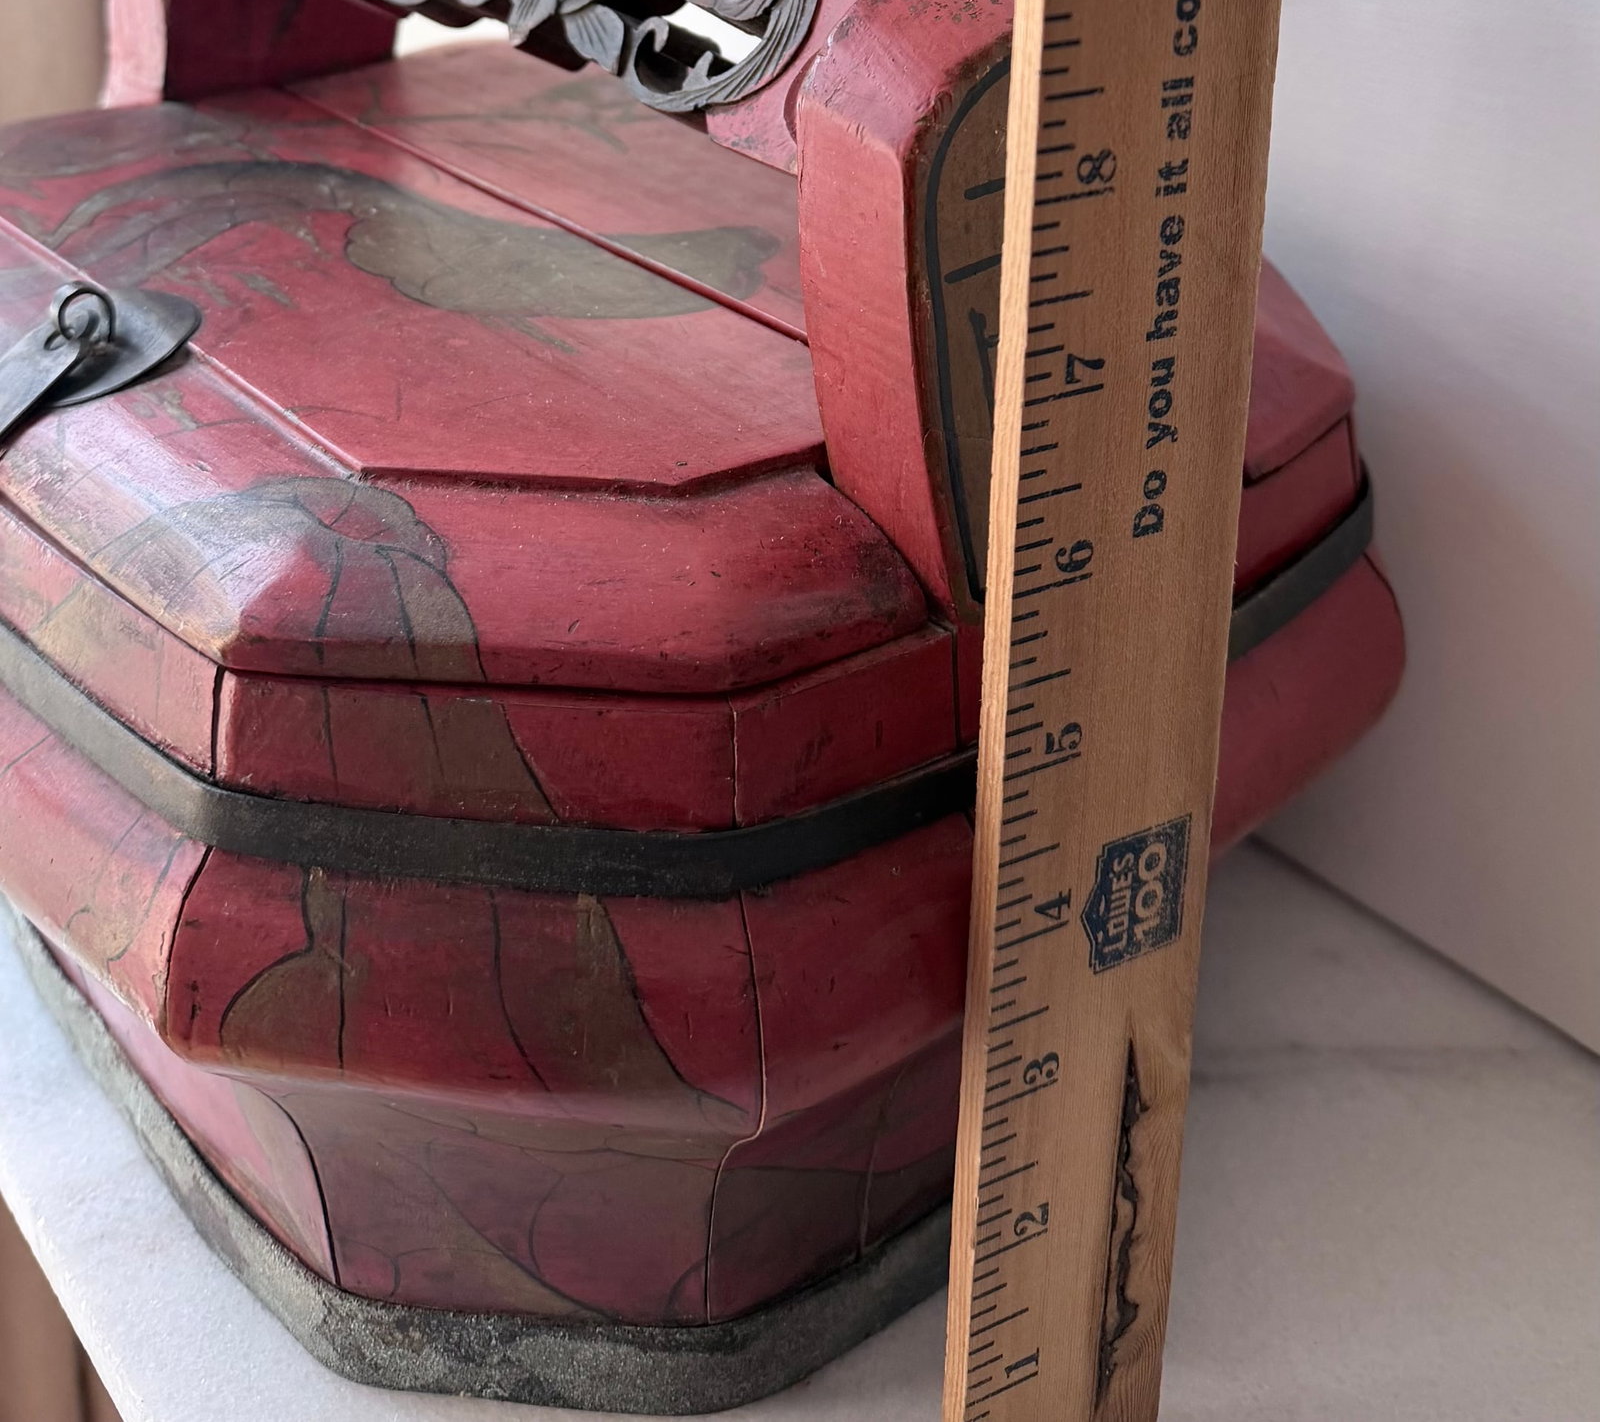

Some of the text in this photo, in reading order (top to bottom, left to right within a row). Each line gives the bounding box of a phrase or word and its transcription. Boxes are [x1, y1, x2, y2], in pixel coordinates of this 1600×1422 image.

[1162, 76, 1194, 140] all
[1077, 148, 1117, 185] 8
[1155, 157, 1189, 198] it
[1146, 214, 1185, 342] have
[1066, 353, 1105, 384] 7
[1146, 356, 1178, 449] you
[1132, 469, 1167, 538] Do
[1055, 539, 1094, 573] 6
[1046, 721, 1082, 754] 5
[1034, 889, 1071, 922] 4
[1134, 842, 1167, 942] 100
[1024, 1051, 1060, 1084] 3
[1013, 1201, 1050, 1237] 2
[1004, 1346, 1040, 1379] 1
